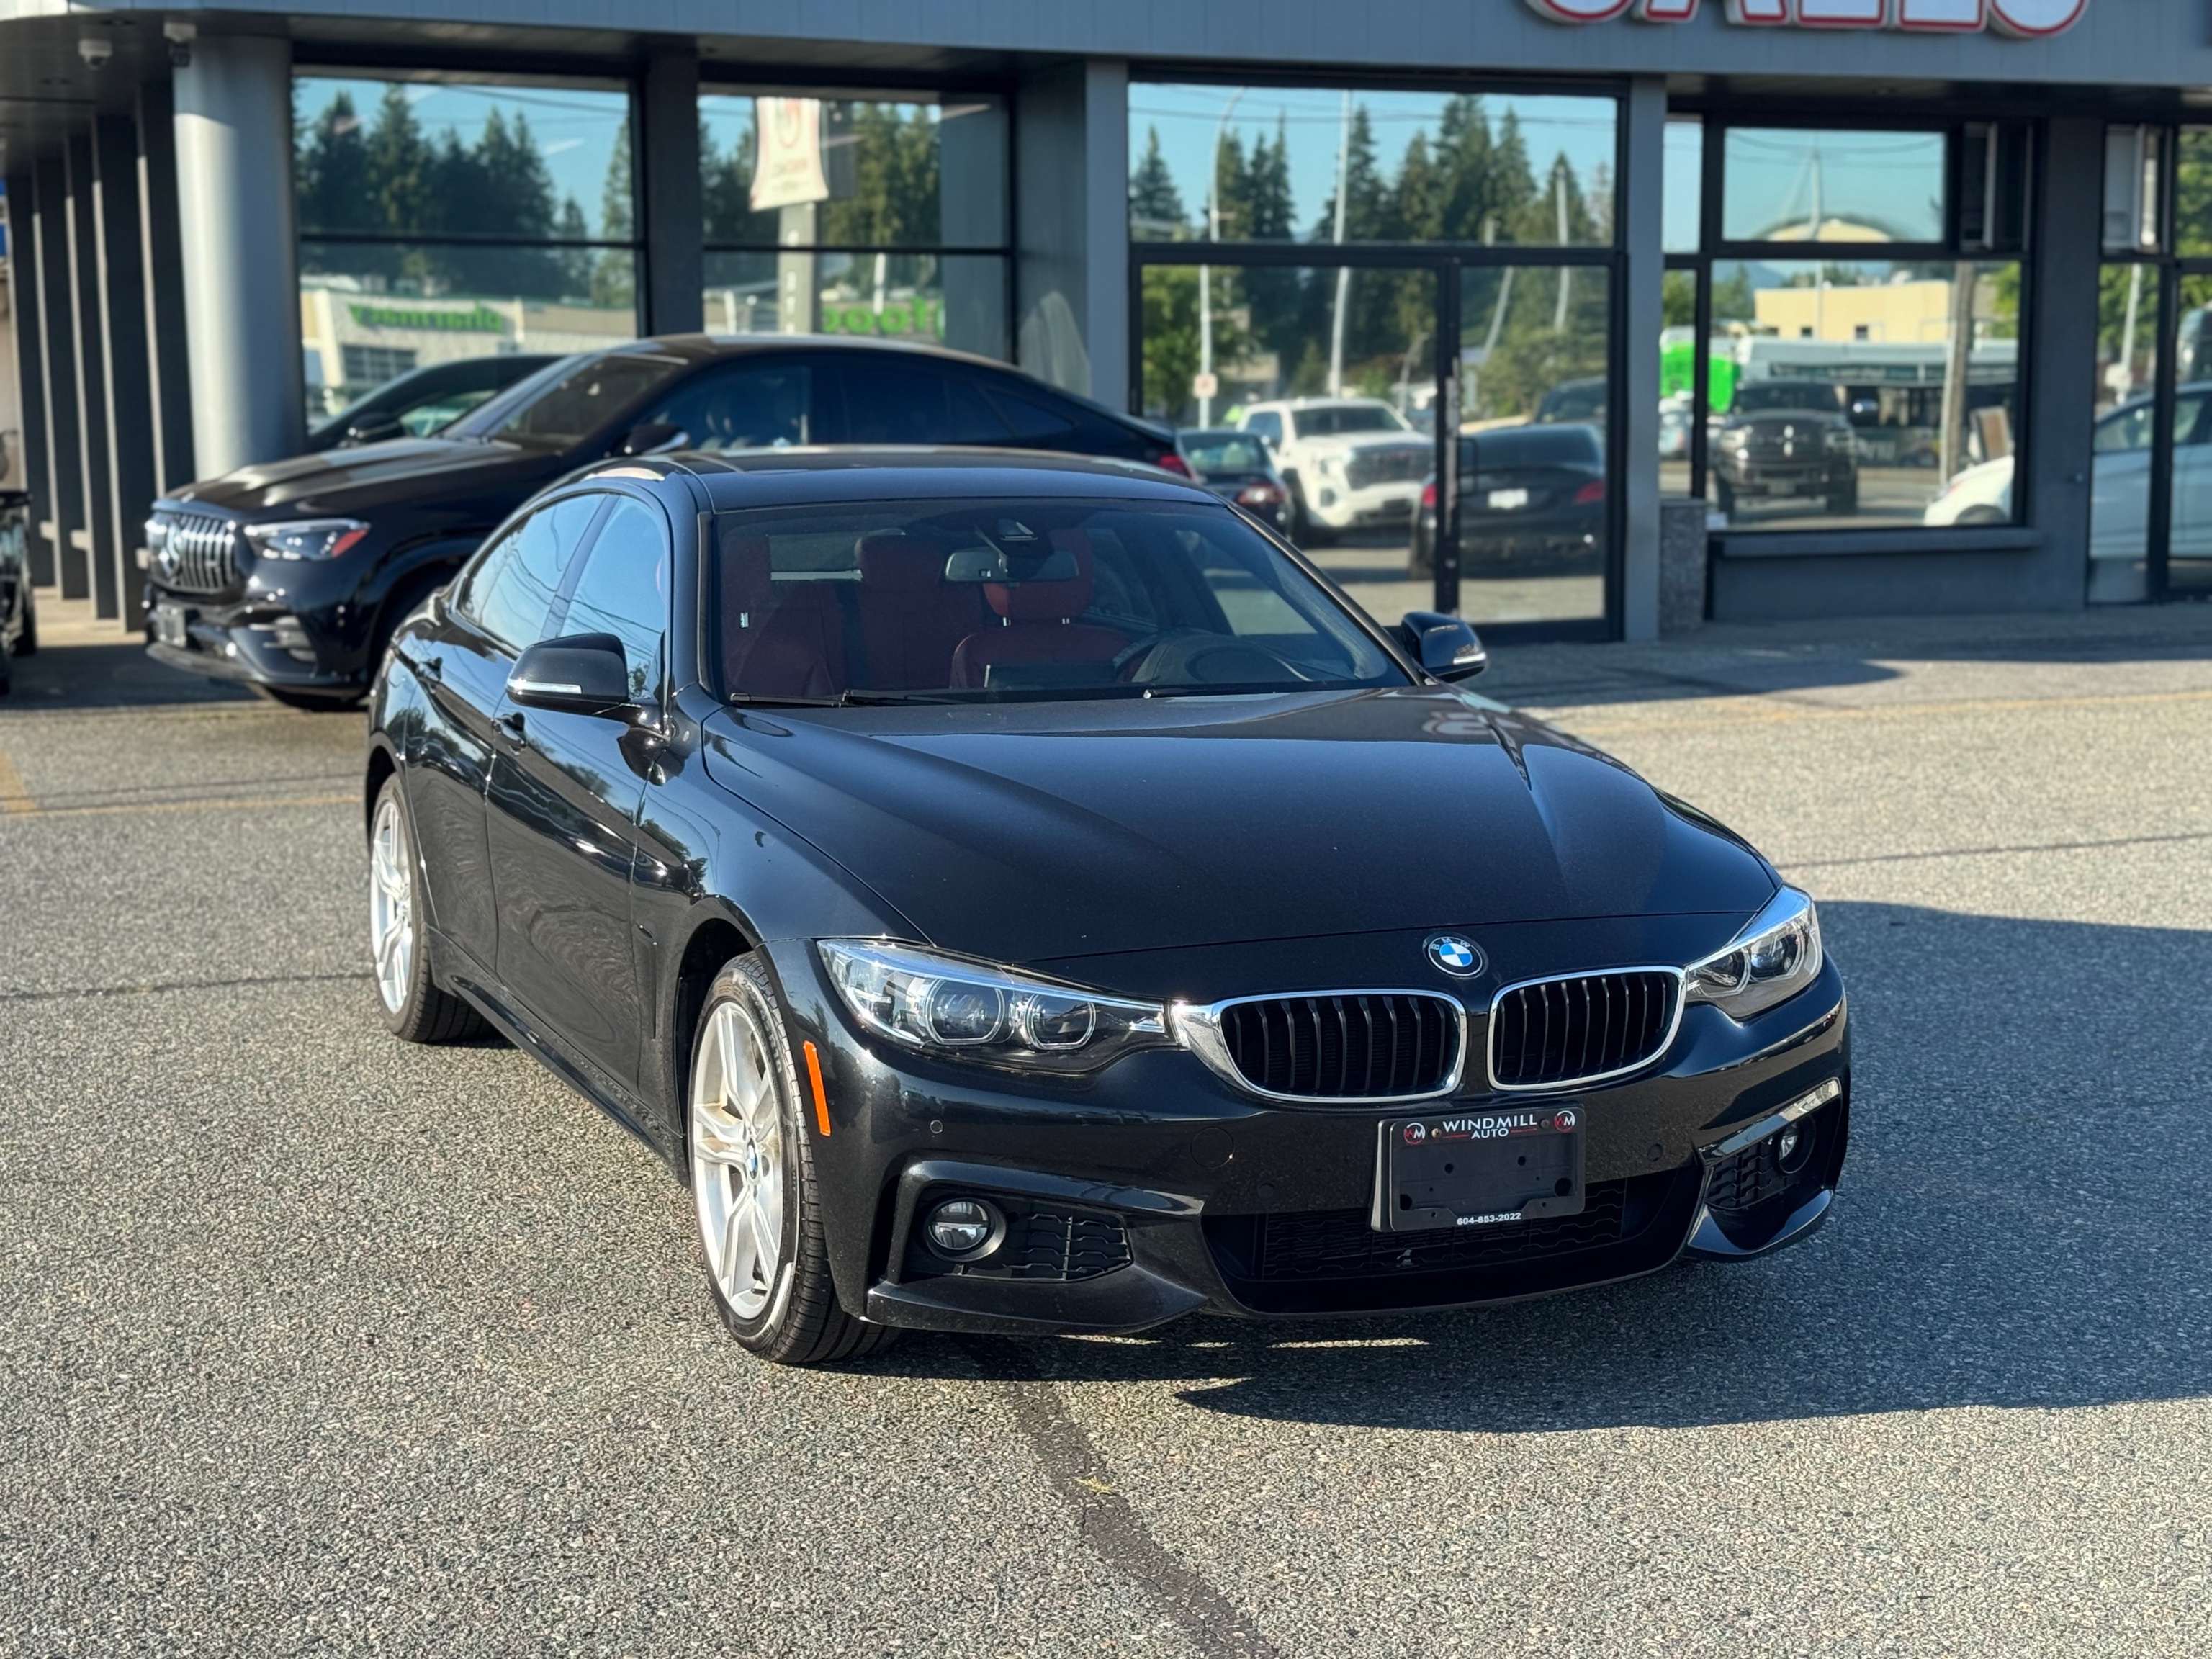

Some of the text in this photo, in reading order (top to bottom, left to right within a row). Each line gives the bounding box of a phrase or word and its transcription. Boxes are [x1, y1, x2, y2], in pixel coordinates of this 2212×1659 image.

[1431, 938, 1470, 950] BMW
[1442, 1114, 1537, 1132] WINDMILL
[1471, 1128, 1509, 1139] AUTO
[1457, 1213, 1521, 1225] 604-853-2022
